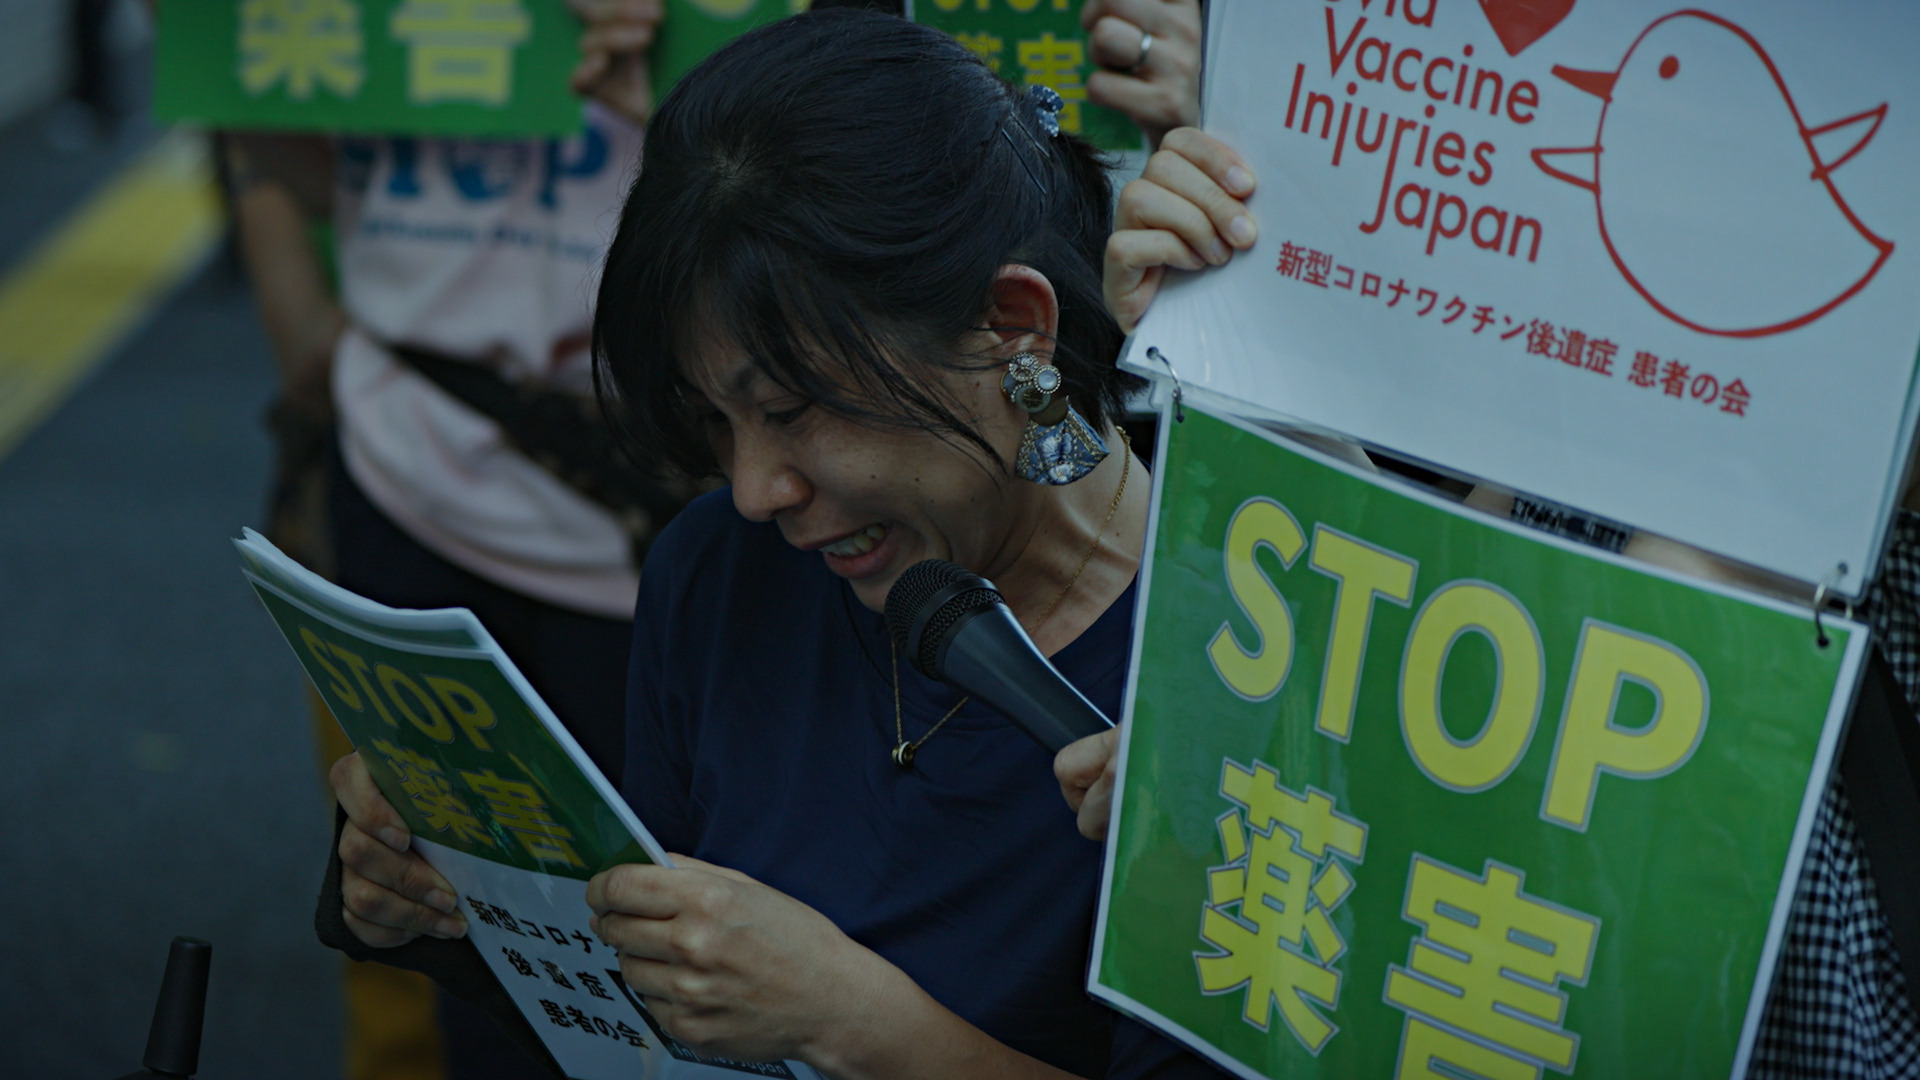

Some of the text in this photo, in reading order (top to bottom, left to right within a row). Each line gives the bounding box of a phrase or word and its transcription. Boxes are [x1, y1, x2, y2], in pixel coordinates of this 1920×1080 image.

[1284, 62, 1496, 186] Injuries
[1325, 7, 1539, 124] Vaccine
[1358, 120, 1542, 263] Japan
[1276, 240, 1751, 416] 新型コロナワクチン後遺症 患者の会
[298, 625, 497, 752] STOP
[1207, 496, 1710, 832] STOP
[370, 736, 589, 871] 薬害
[465, 896, 618, 957] 新型コロナ
[1192, 757, 1601, 1080] 薬害
[538, 999, 649, 1049] 患者の会
